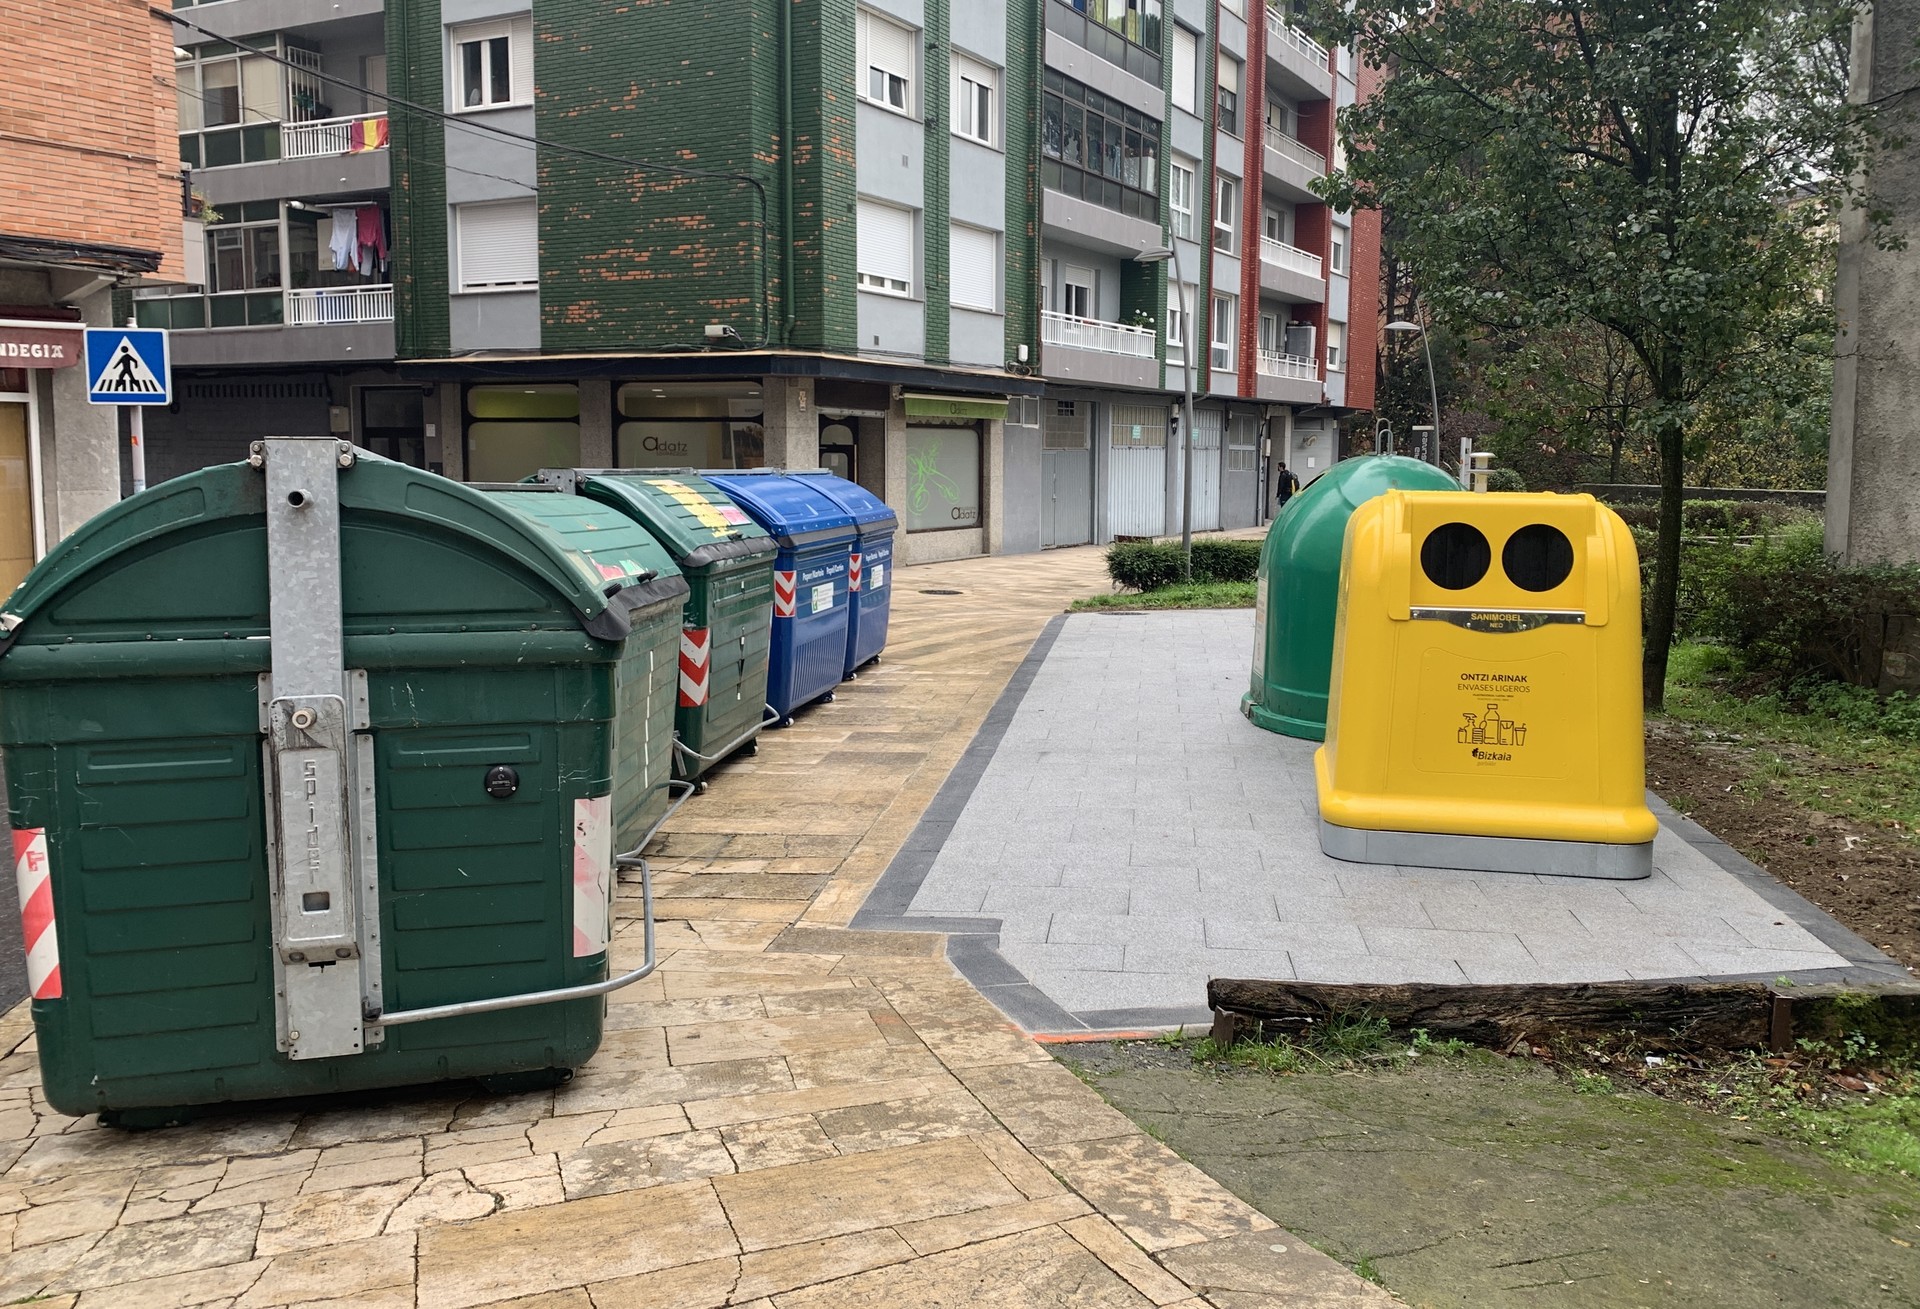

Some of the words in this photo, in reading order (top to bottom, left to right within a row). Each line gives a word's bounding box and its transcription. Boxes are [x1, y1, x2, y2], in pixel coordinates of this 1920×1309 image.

[642, 436, 688, 452] adatz
[951, 507, 976, 520] adatz
[1471, 613, 1523, 622] SANIMOBEL
[1460, 673, 1490, 681] ONTZI
[1491, 674, 1528, 683] ARINAK
[1457, 683, 1494, 692] ENVASES
[1495, 685, 1531, 693] LIGEROS
[1478, 751, 1512, 761] Bizkaia
